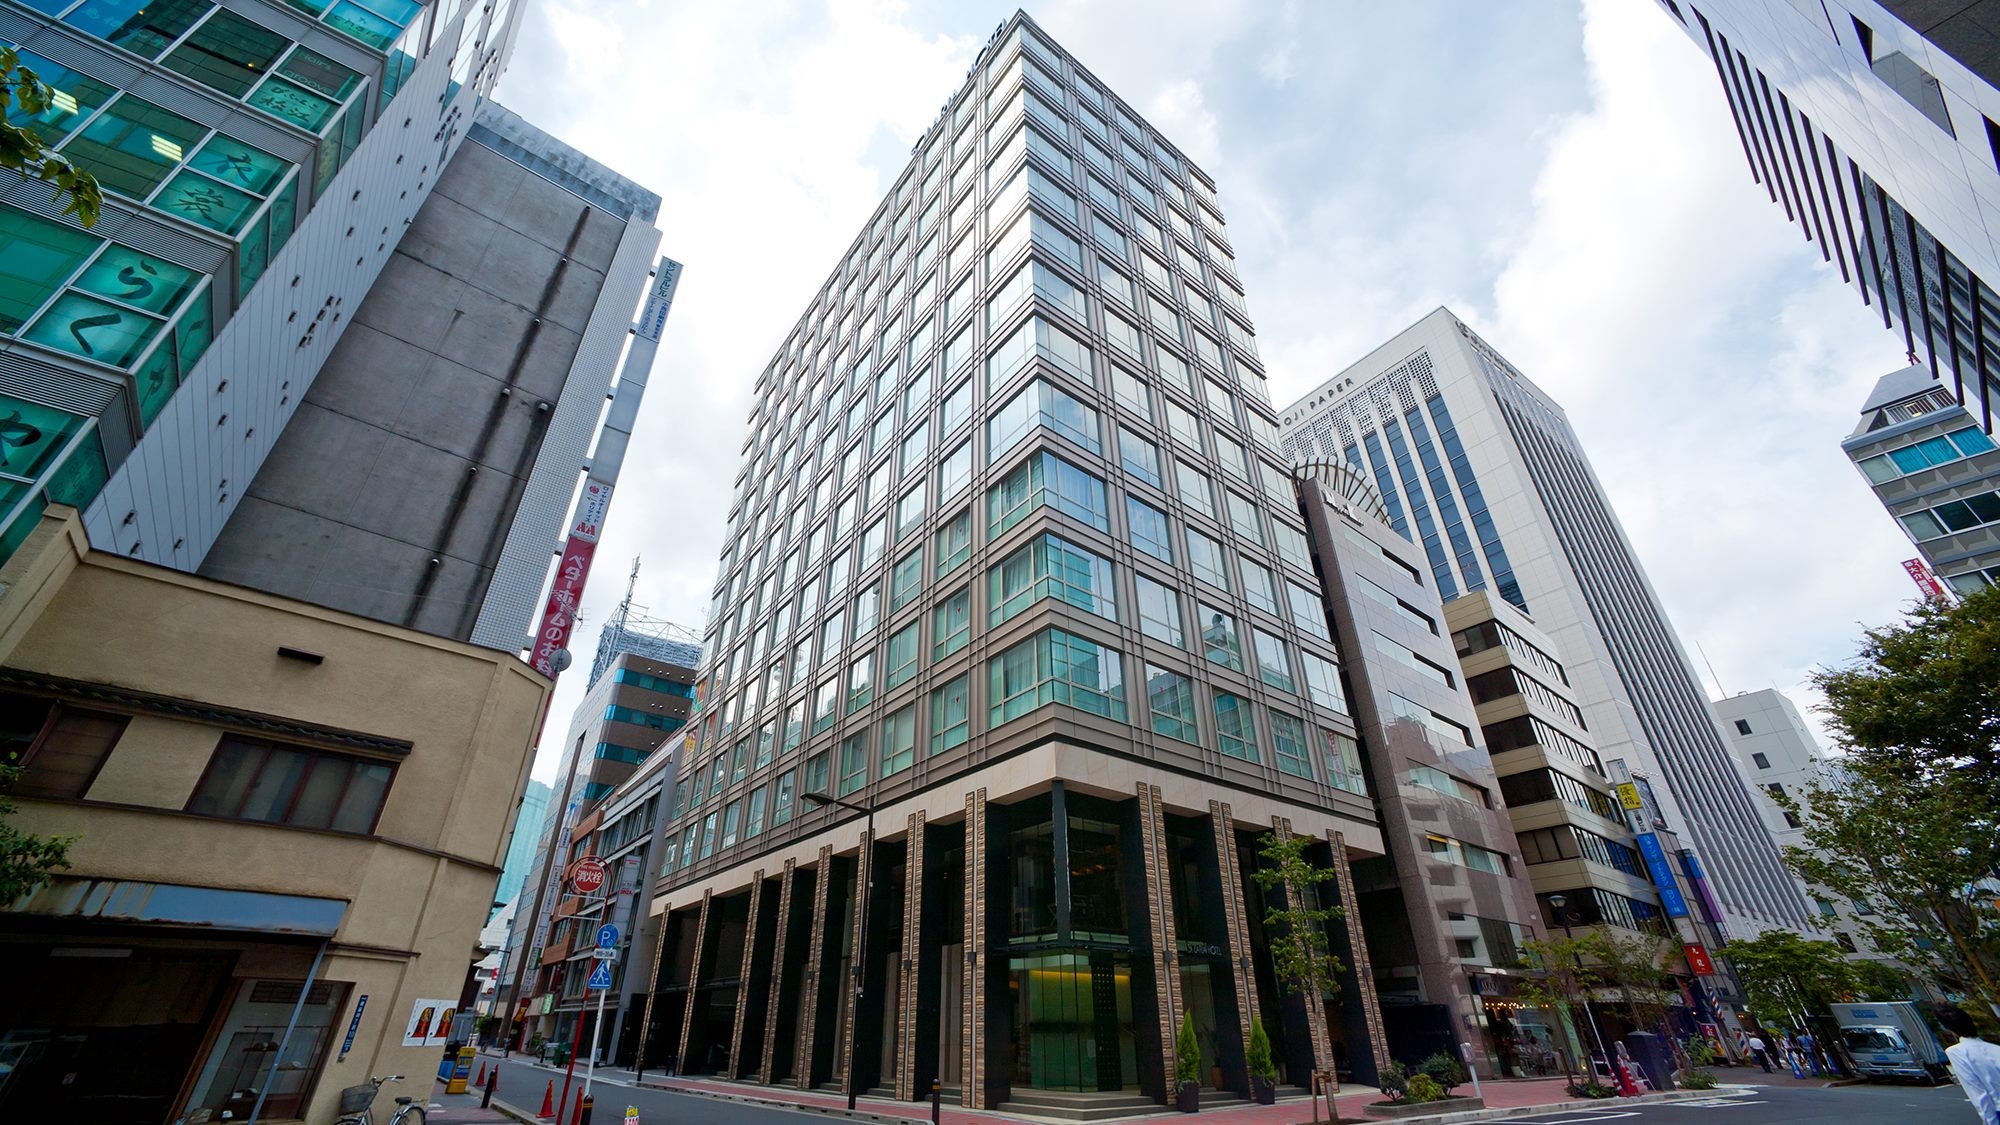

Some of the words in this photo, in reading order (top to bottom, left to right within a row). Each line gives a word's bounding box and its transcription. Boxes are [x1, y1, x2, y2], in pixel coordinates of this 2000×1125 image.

[1284, 408, 1304, 426] OJI
[1309, 377, 1354, 410] PAPER
[576, 869, 603, 884] 消火栓
[600, 930, 611, 946] P
